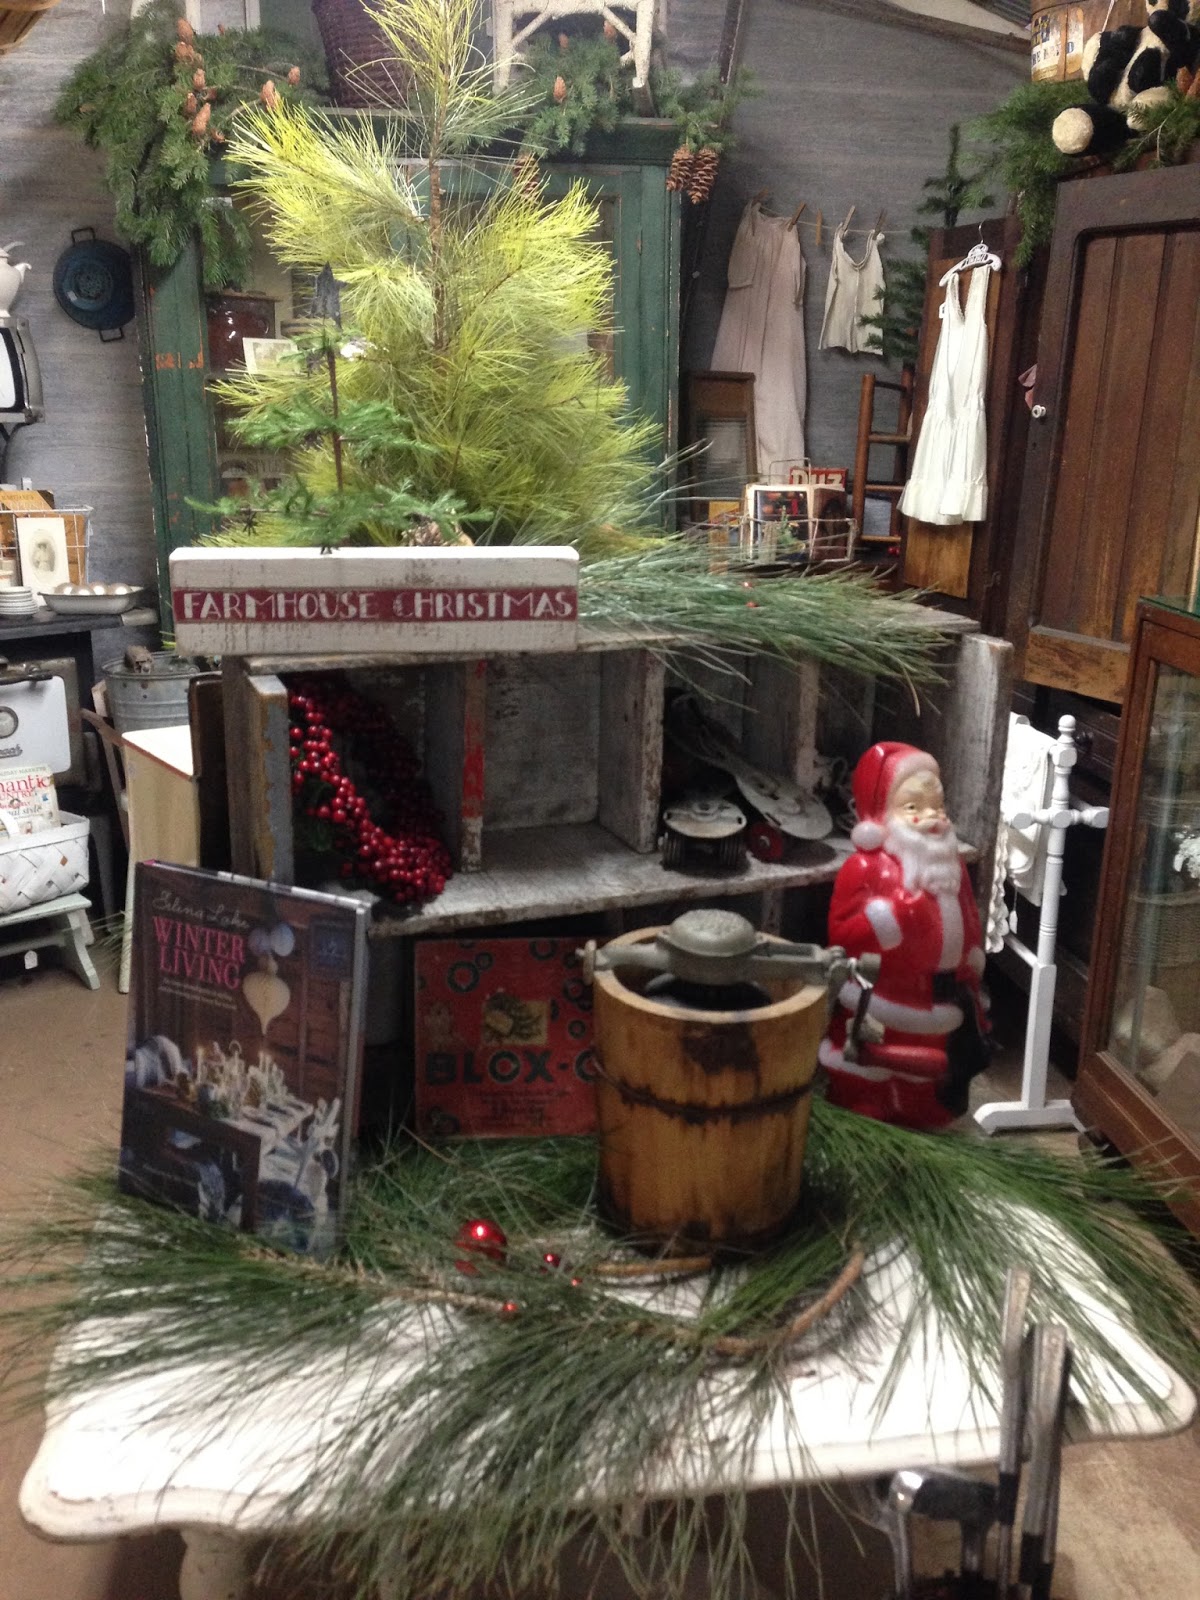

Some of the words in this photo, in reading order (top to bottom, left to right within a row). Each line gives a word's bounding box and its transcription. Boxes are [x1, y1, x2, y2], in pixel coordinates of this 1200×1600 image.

[183, 592, 380, 619] FARMHOUSE
[392, 591, 573, 618] CHRISTMAS
[152, 916, 246, 964] WINTER
[159, 944, 242, 990] LIVING
